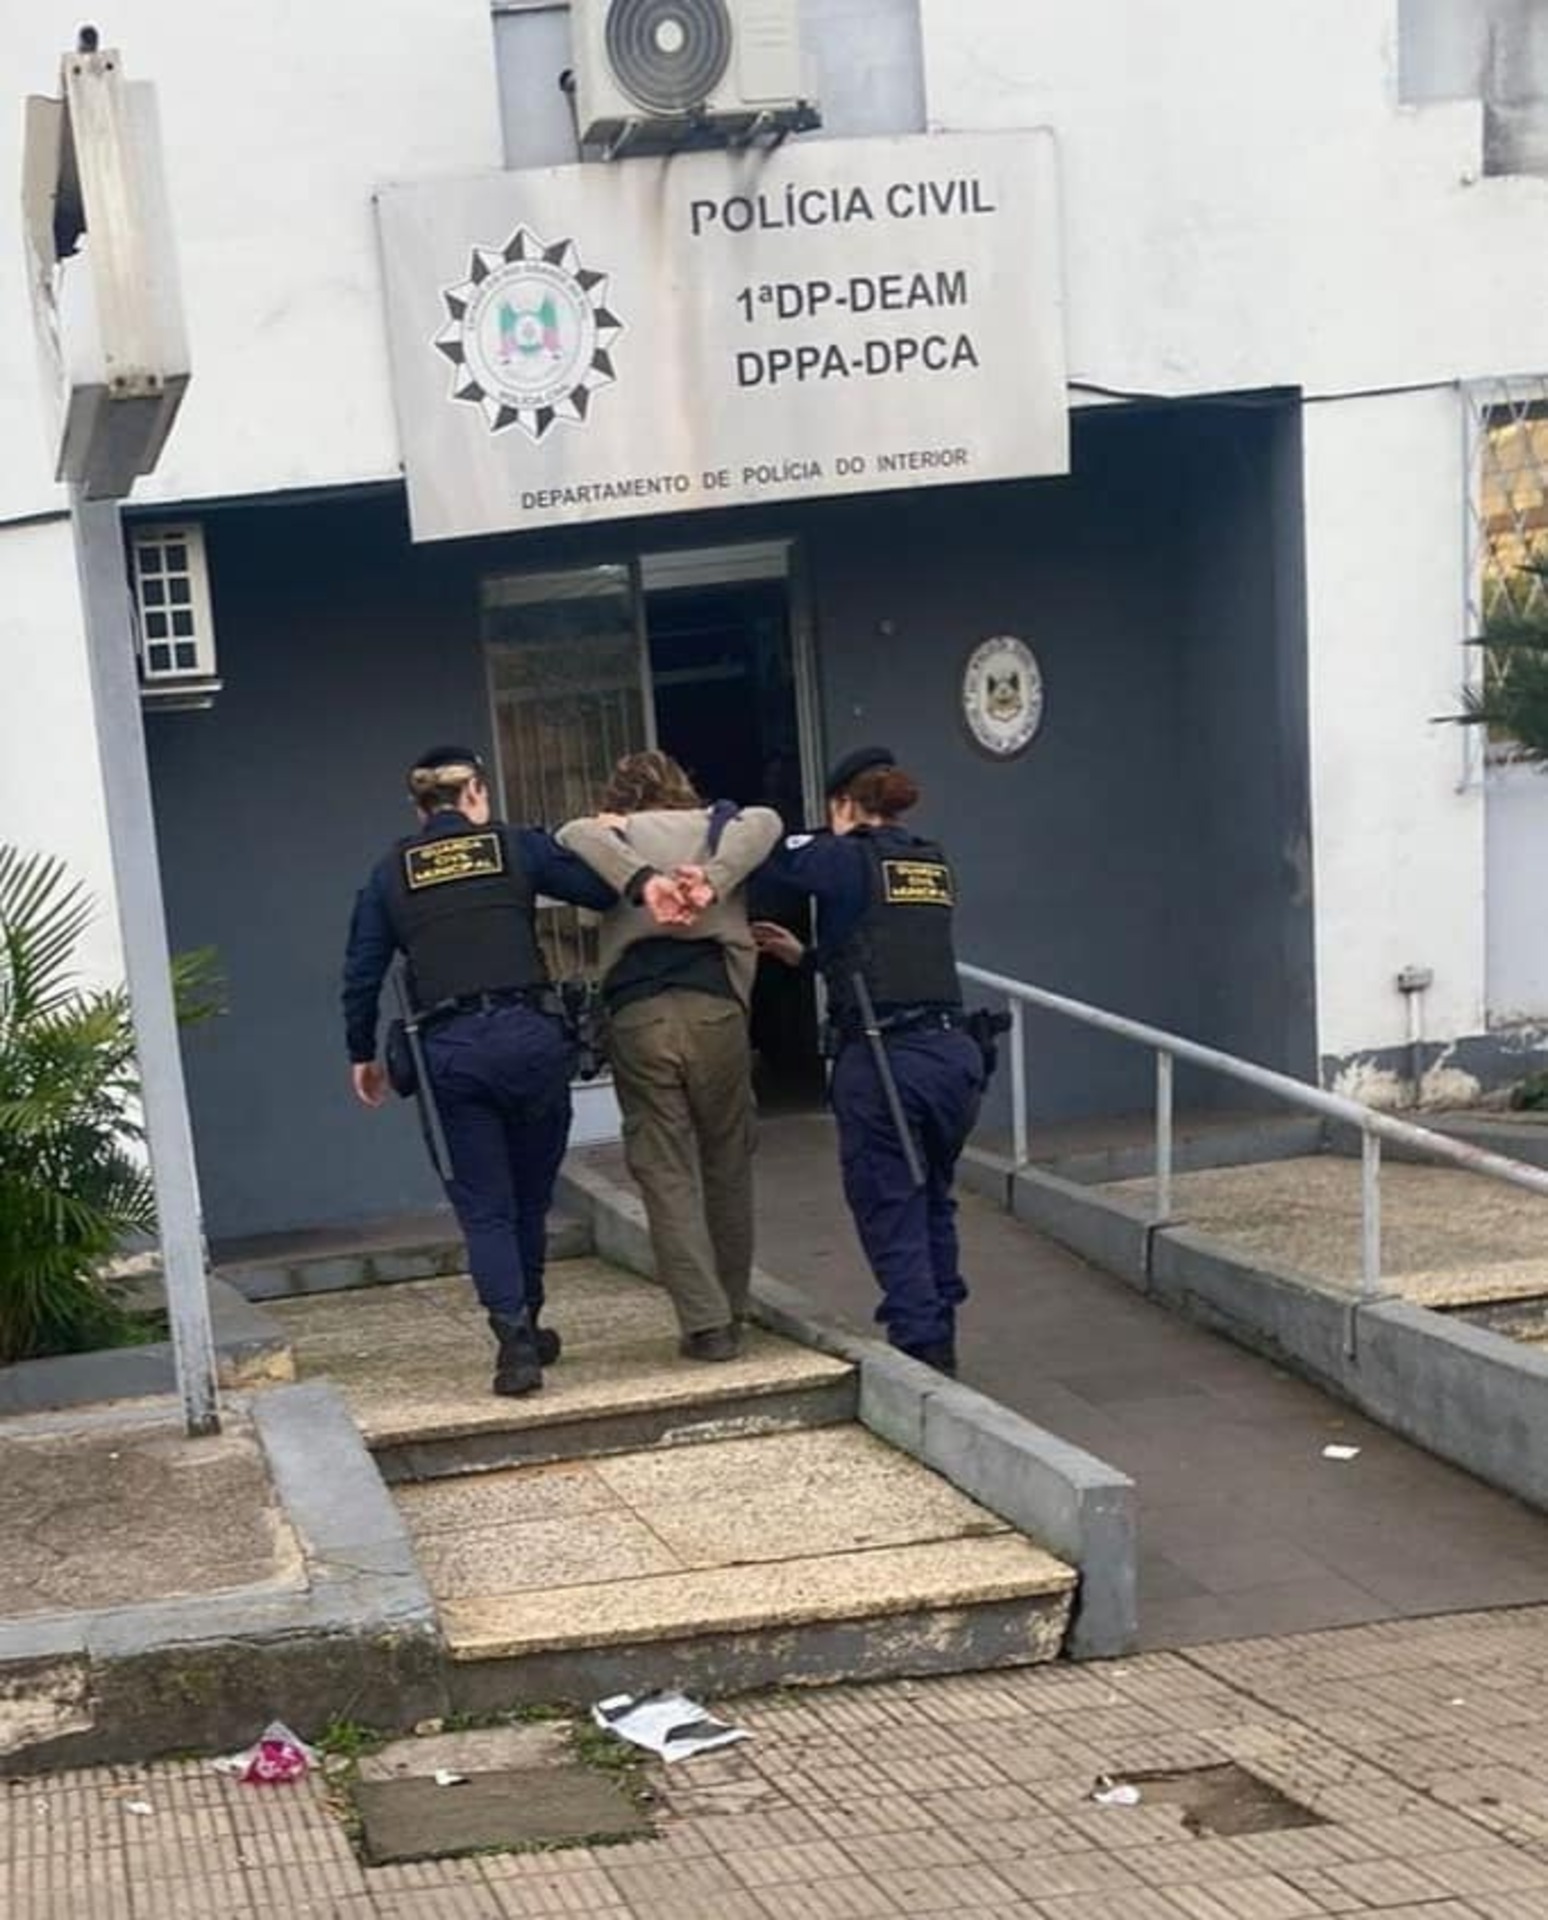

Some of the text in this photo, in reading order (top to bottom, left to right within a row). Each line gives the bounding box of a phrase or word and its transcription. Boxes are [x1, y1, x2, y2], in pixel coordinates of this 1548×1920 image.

[691, 180, 994, 235] POLÍCIA CIVIL
[737, 270, 967, 322] 1ªDP-DEAM
[736, 334, 978, 387] DPPA-DPCA
[521, 448, 968, 509] DEPARTAMENTO DE POLÍCIA DO INTERIOR
